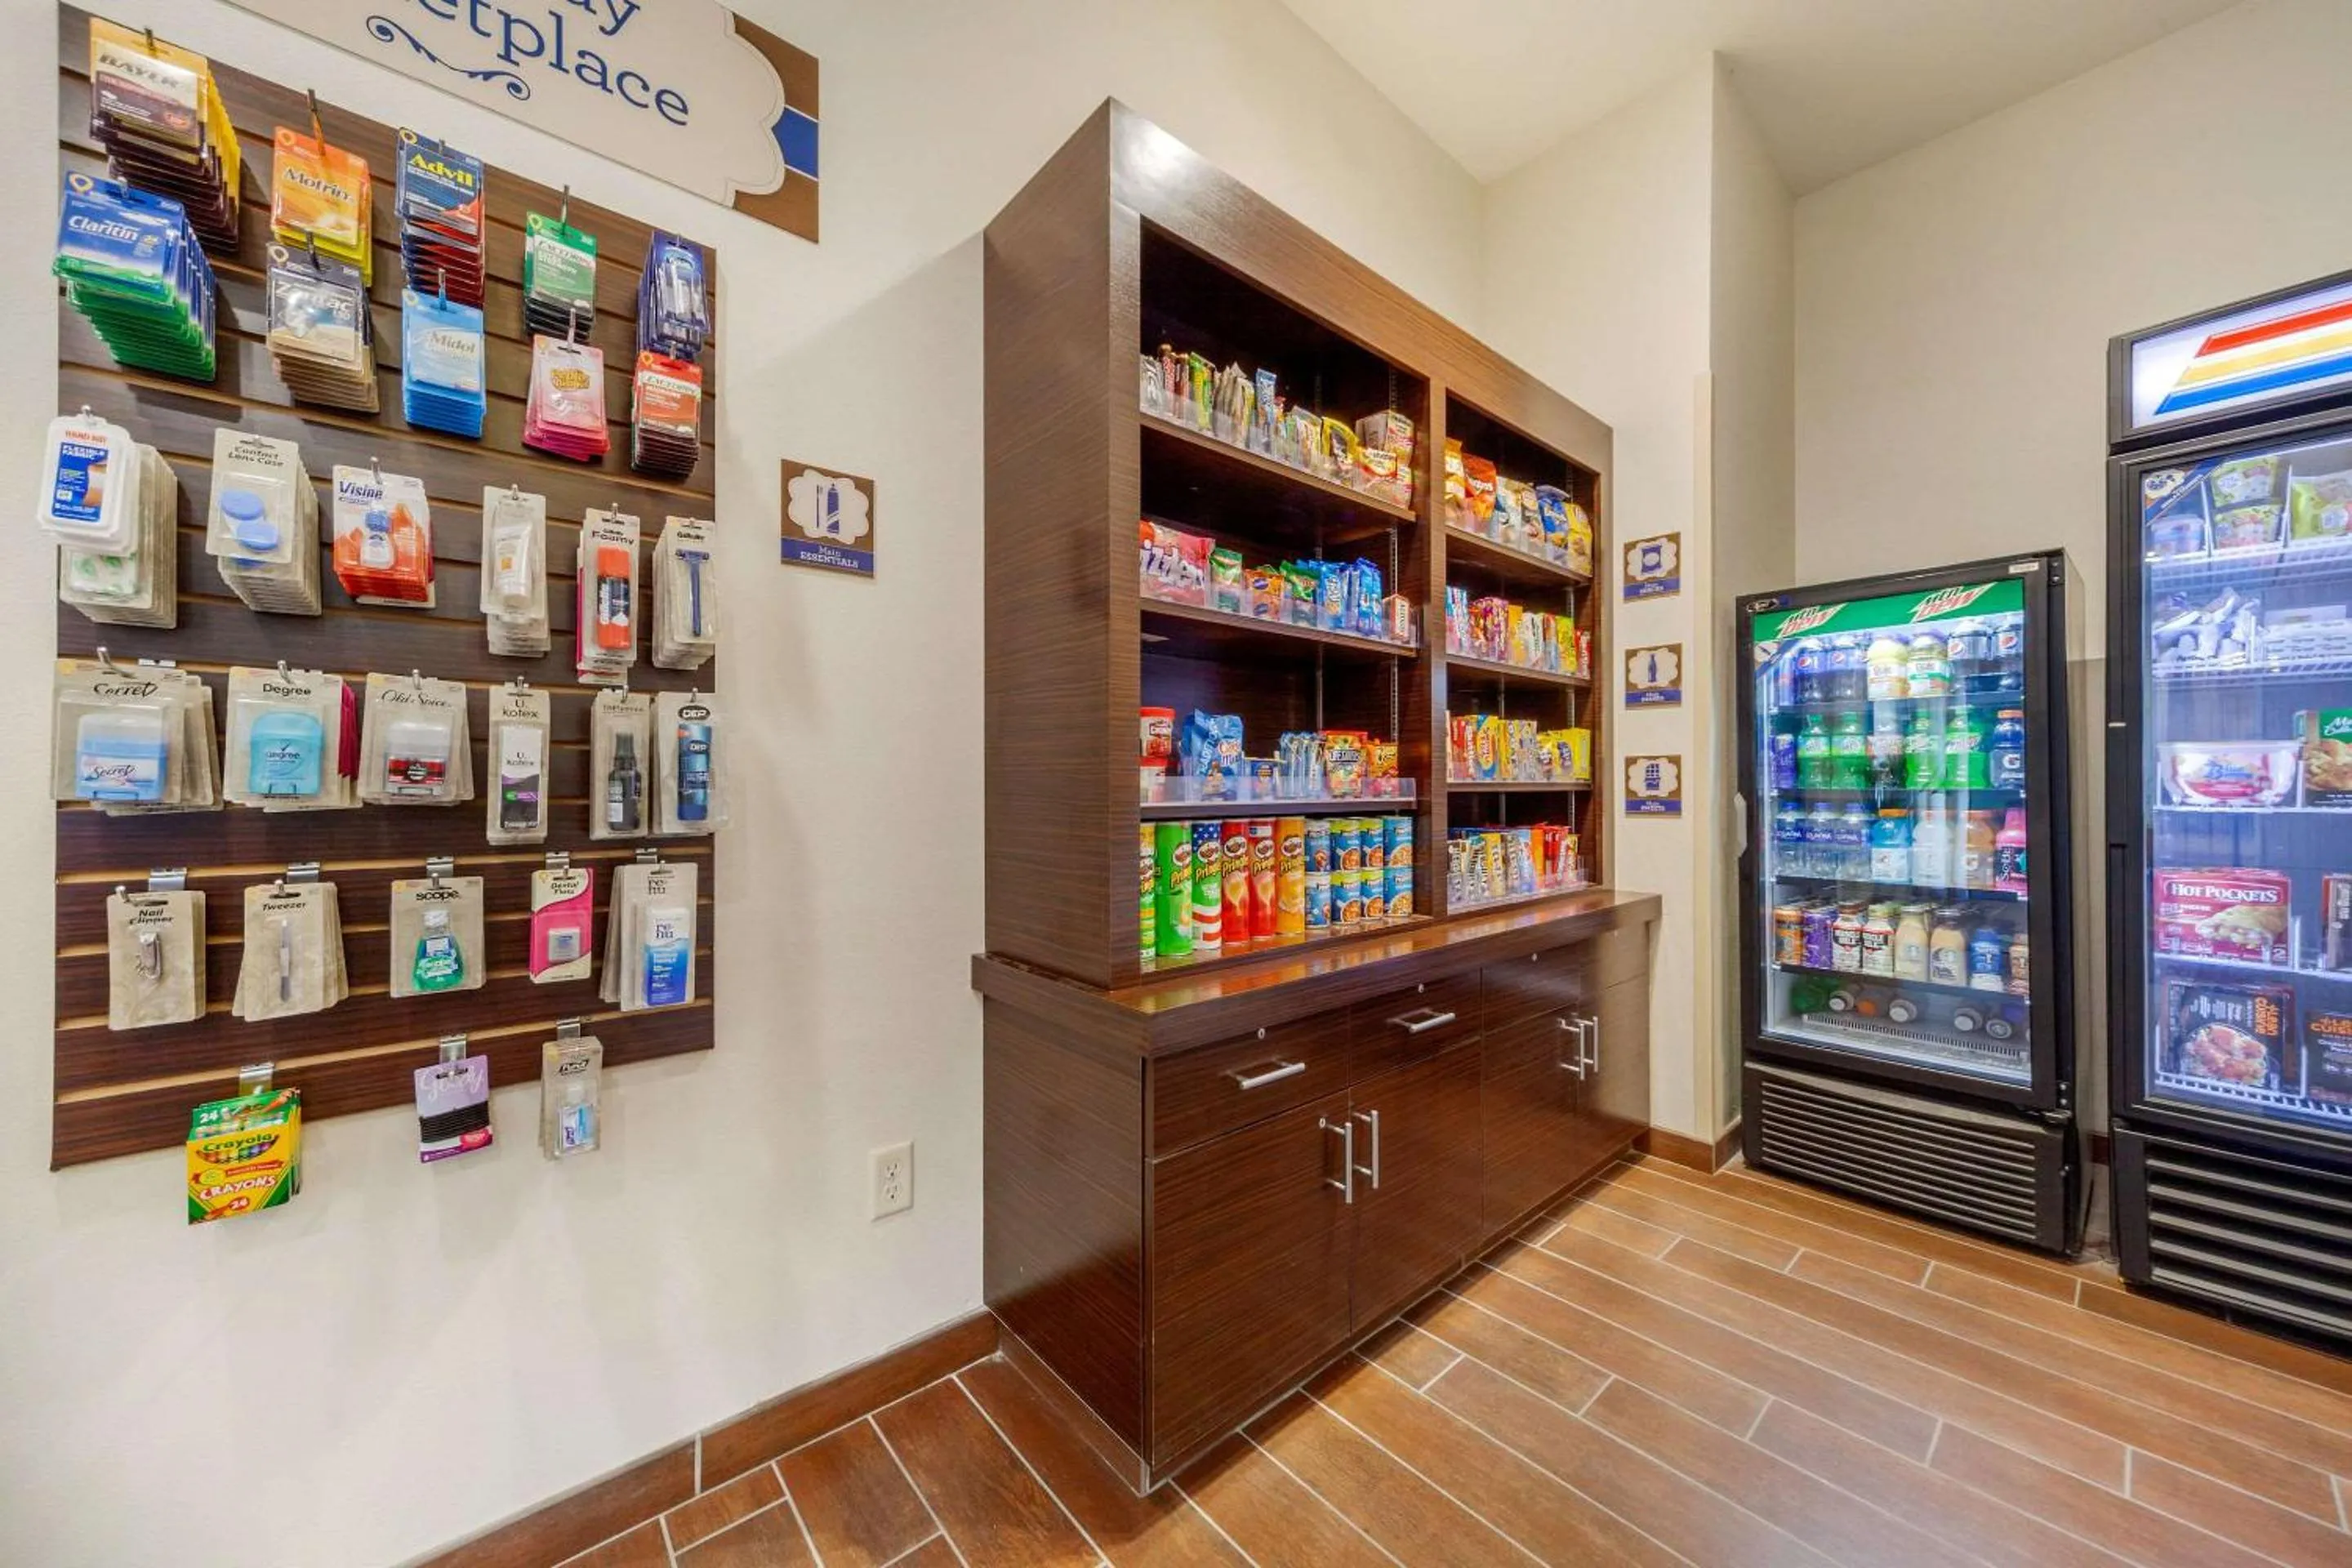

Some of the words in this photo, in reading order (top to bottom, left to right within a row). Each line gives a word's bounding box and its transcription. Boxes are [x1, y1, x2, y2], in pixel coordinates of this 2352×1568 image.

[408, 153, 474, 187] Advil
[283, 166, 354, 202] Motrin
[69, 215, 140, 242] Claritin
[228, 453, 256, 462] Lens
[257, 457, 284, 467] Case
[234, 447, 278, 460] Contact
[339, 480, 383, 500] Visine
[591, 531, 635, 546] Foamy
[800, 551, 858, 568] ESSENTIALS
[263, 684, 311, 697] Degree
[2002, 753, 2021, 769] G
[2171, 883, 2202, 897] HOT
[2204, 885, 2278, 903] POCKETS
[139, 908, 164, 917] Nail
[262, 902, 307, 911] Tweezer
[130, 915, 174, 925] Clipper
[199, 1111, 218, 1123] 24
[203, 1133, 272, 1152] Crayola
[199, 1175, 276, 1200] CRAYONS
[230, 1198, 249, 1209] 24
